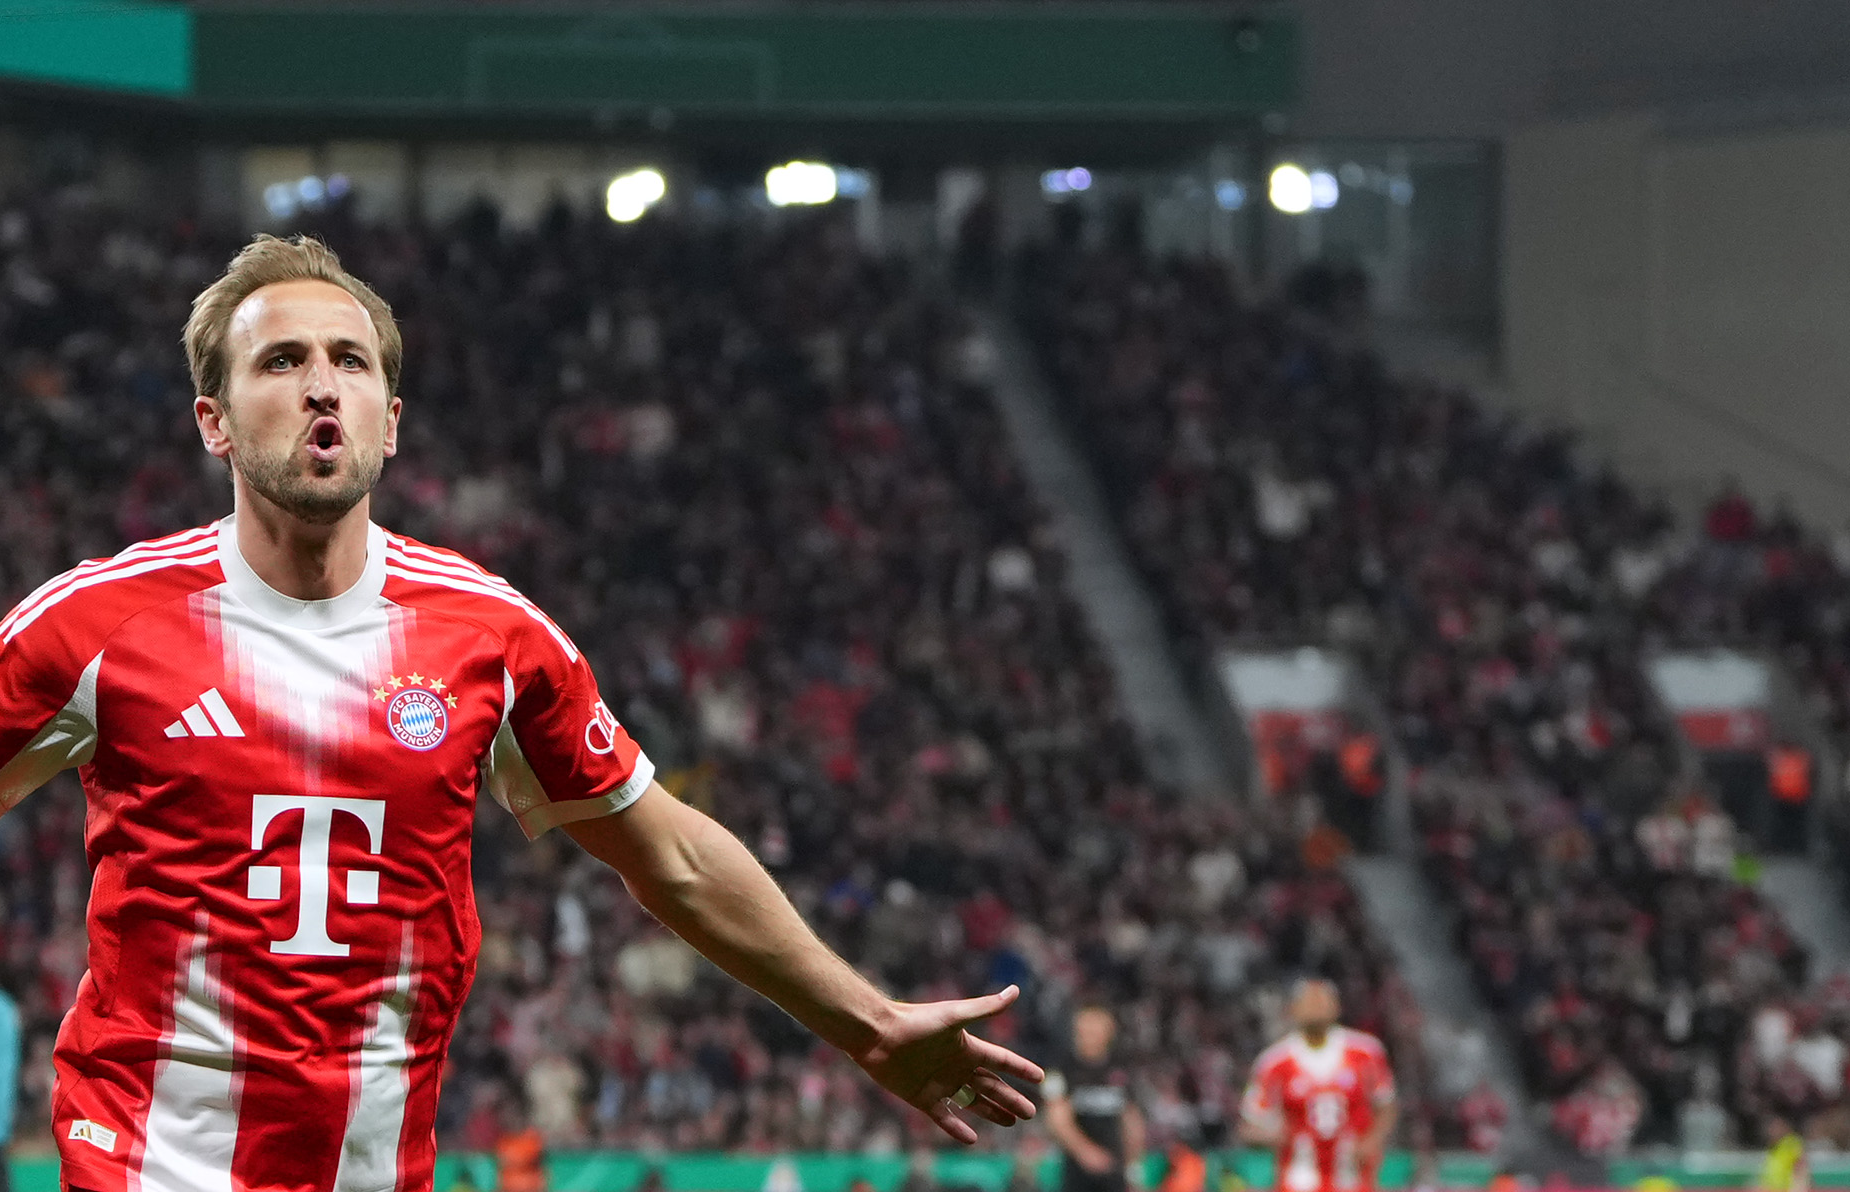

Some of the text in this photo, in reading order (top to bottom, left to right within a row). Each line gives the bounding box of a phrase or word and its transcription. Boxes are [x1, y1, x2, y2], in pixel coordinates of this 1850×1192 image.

[392, 693, 443, 718] FC BAYERN
[248, 794, 386, 957] T
